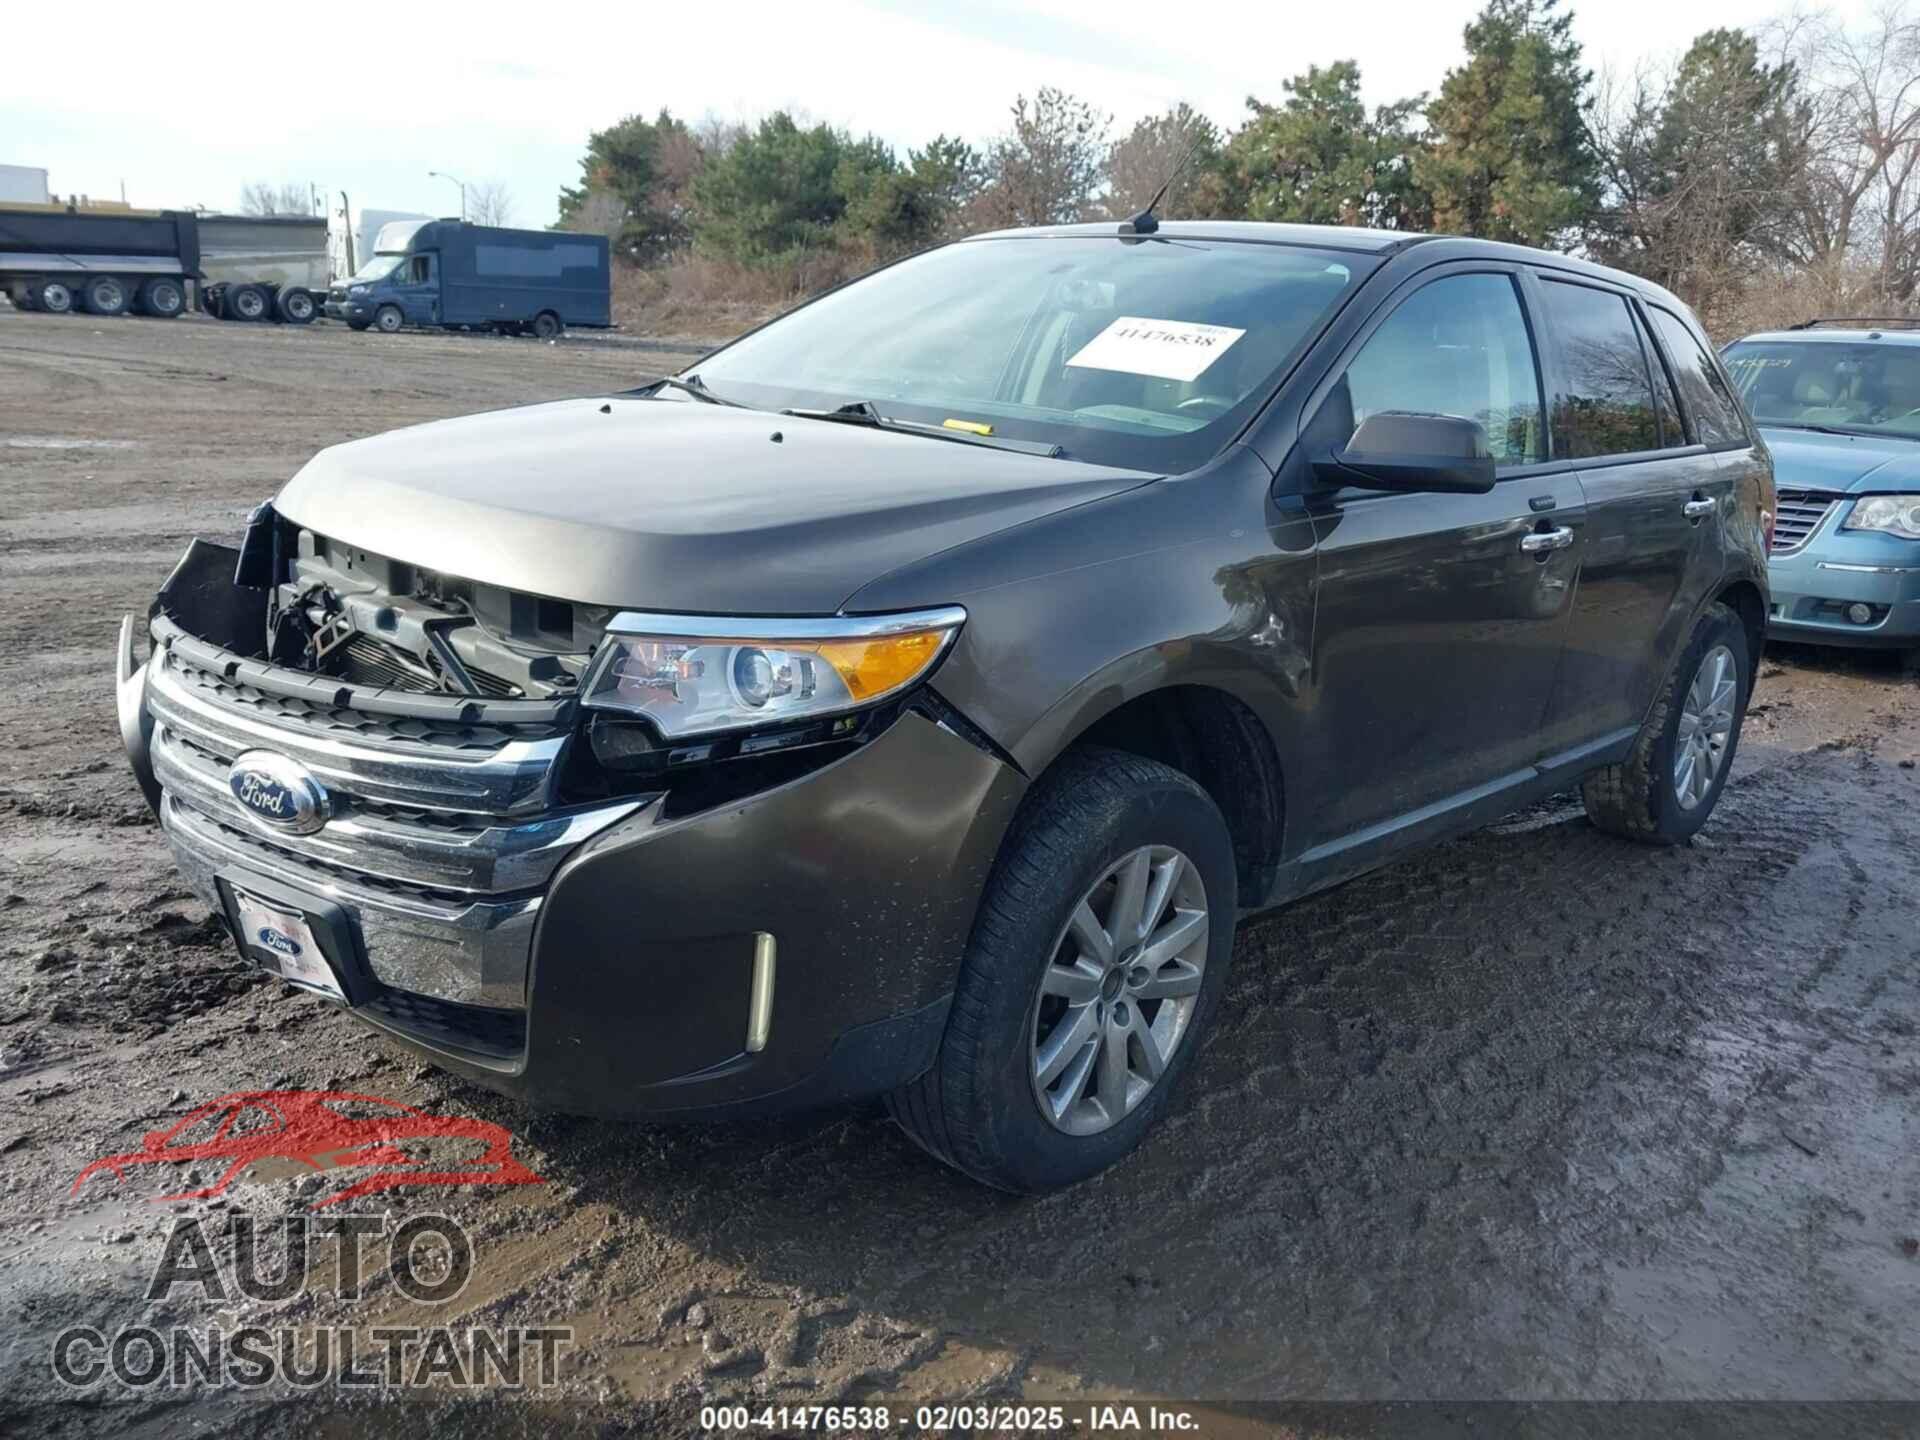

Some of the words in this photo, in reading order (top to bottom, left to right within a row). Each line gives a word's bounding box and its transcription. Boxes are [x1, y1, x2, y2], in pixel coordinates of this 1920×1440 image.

[1115, 326, 1216, 348] 41476538
[240, 772, 285, 814] Ford
[267, 930, 296, 954] Ford
